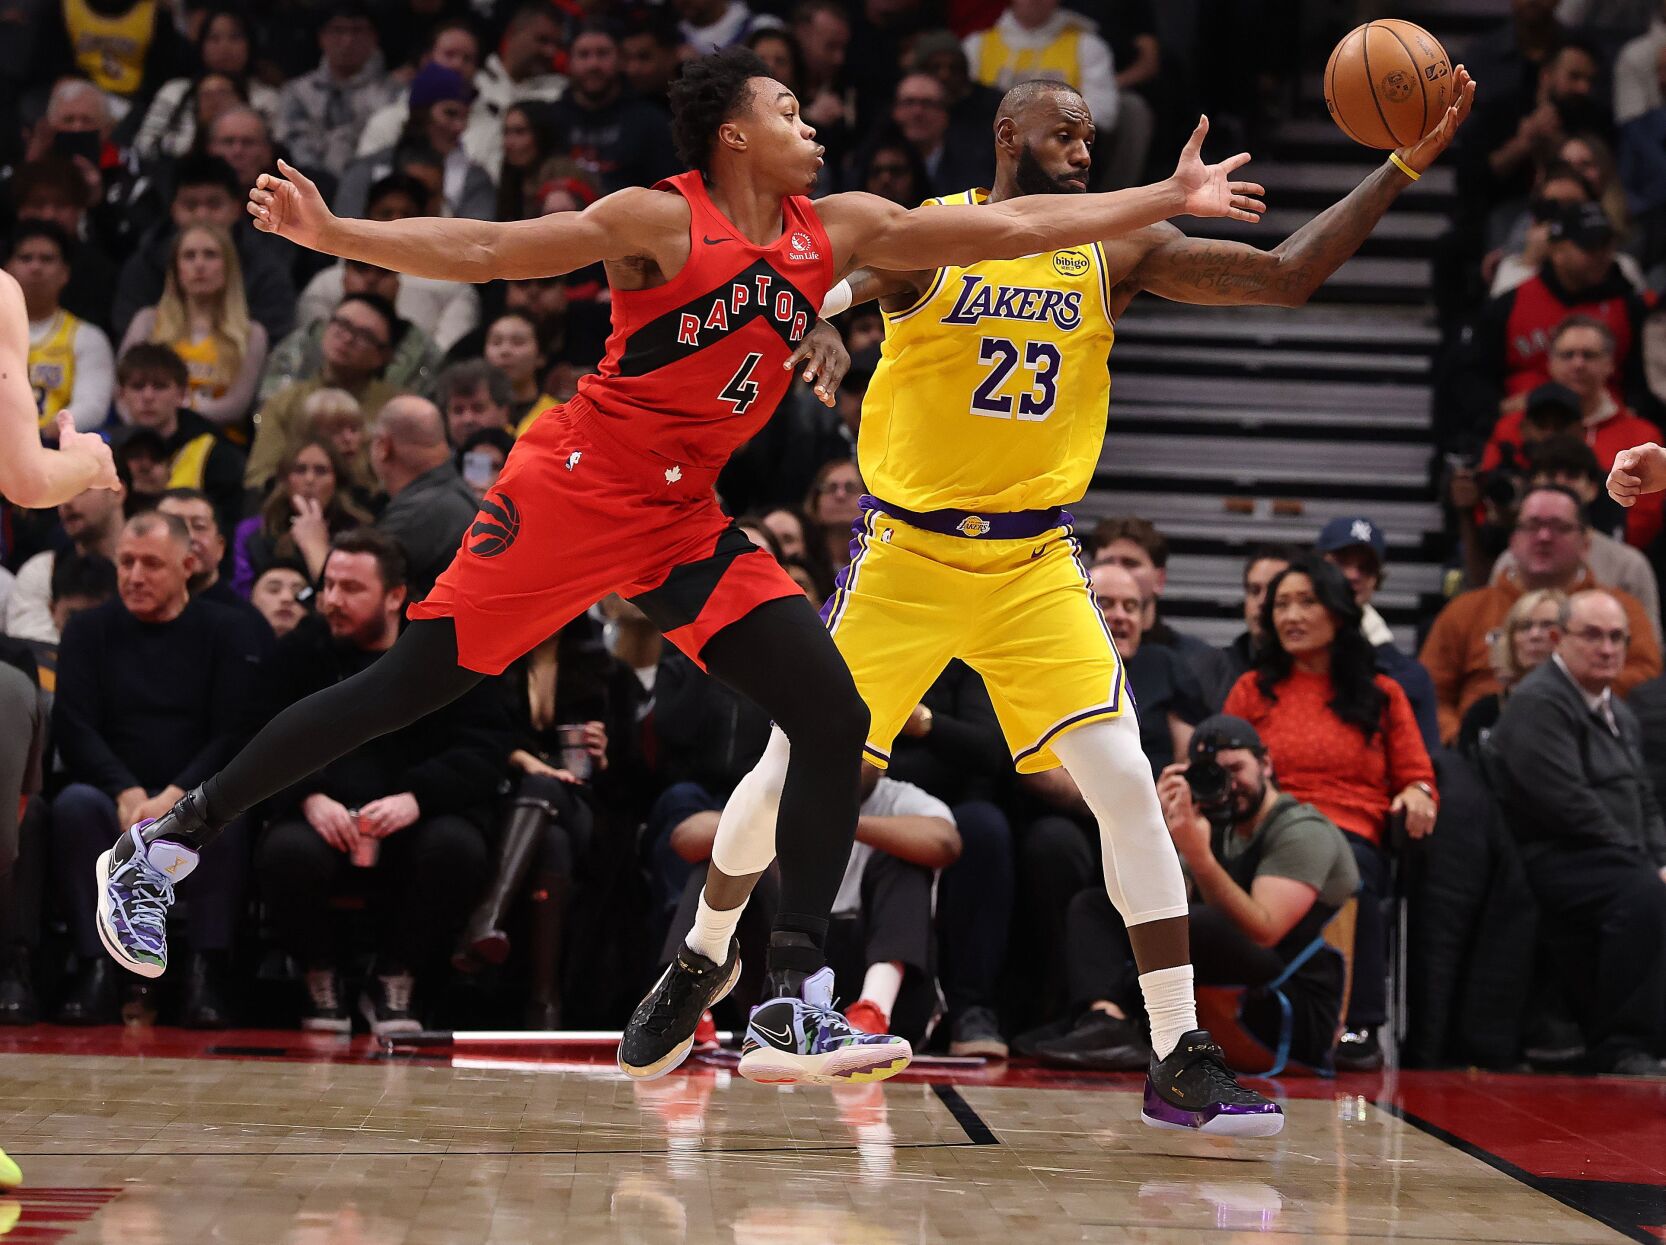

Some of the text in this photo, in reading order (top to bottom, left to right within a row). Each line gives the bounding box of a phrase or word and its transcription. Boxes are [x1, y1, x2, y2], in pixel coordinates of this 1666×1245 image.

[790, 251, 820, 260] Sun Life
[1055, 256, 1087, 270] bibigo
[677, 275, 807, 346] RAPTOR
[939, 275, 1084, 332] LAKERS
[717, 352, 763, 414] 4
[970, 336, 1063, 422] 23
